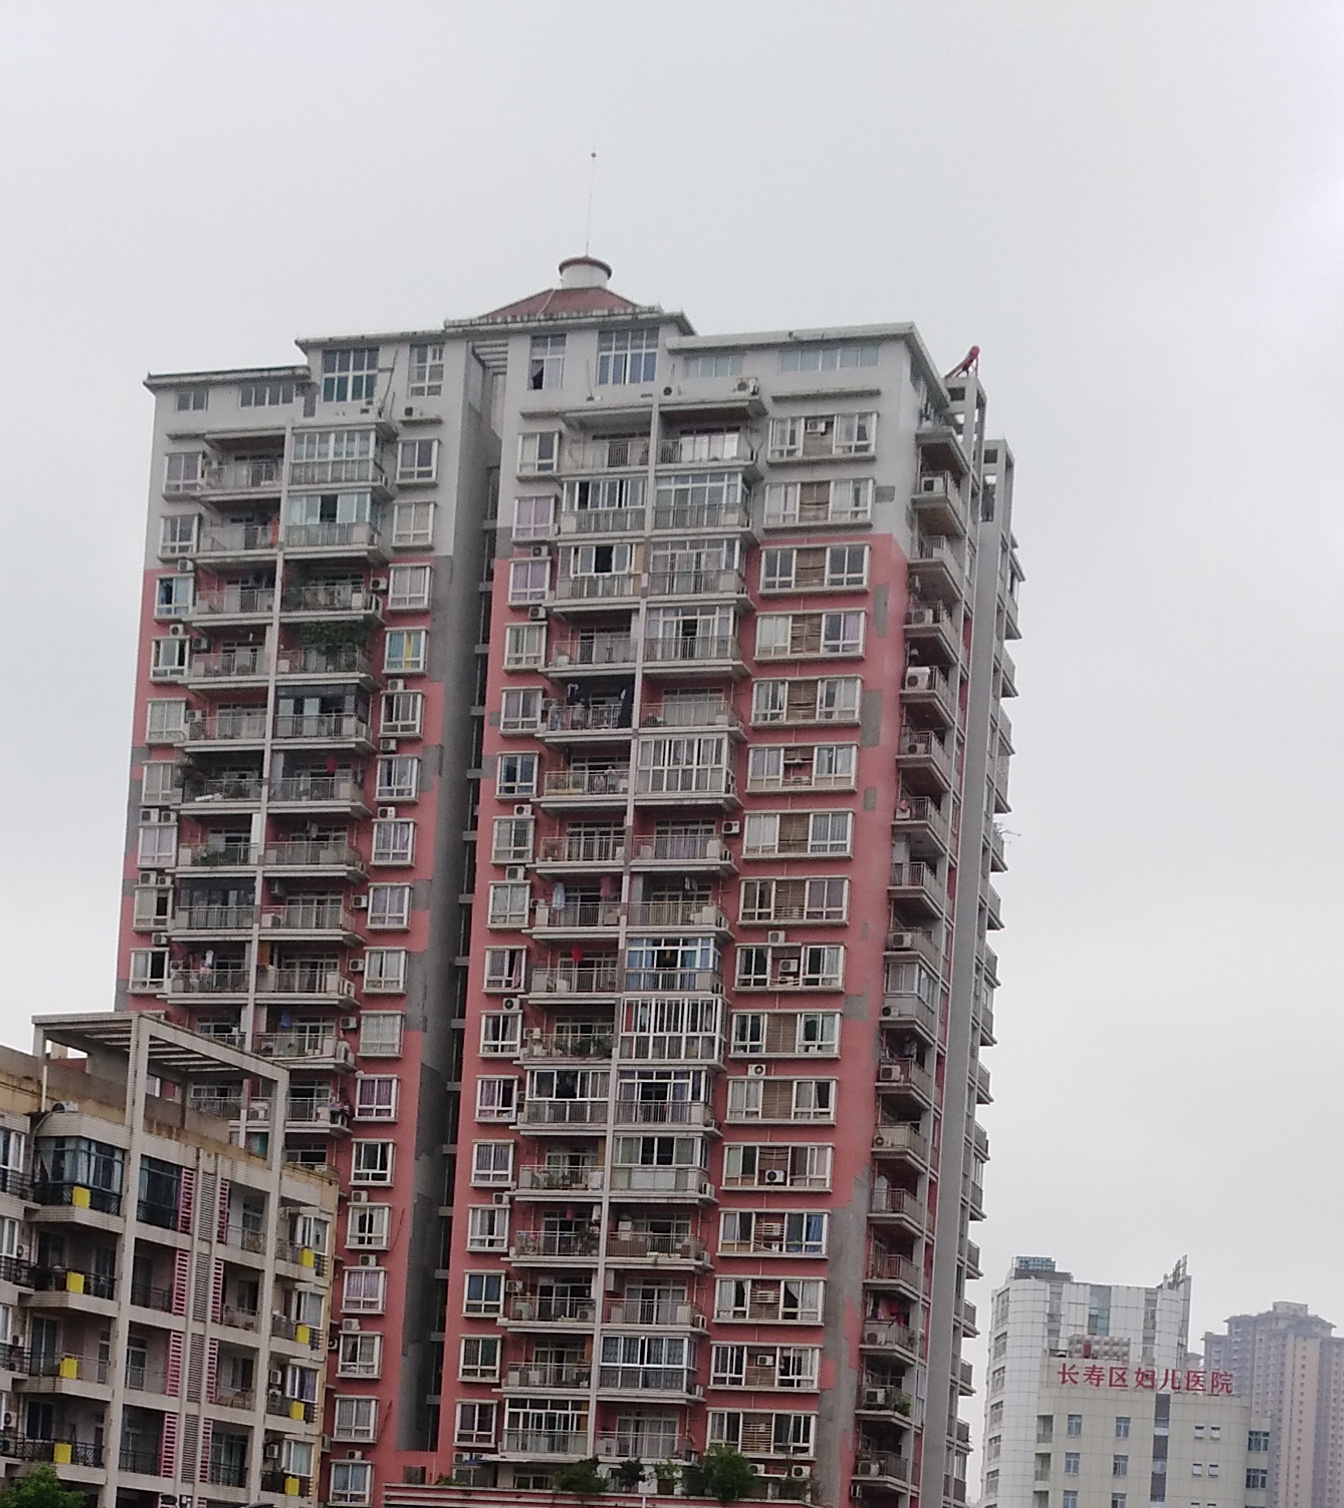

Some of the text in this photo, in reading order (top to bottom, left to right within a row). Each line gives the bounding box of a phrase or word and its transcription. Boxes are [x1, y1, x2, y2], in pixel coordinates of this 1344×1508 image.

[1057, 1363, 1234, 1393] 长寿区妇儿医院
